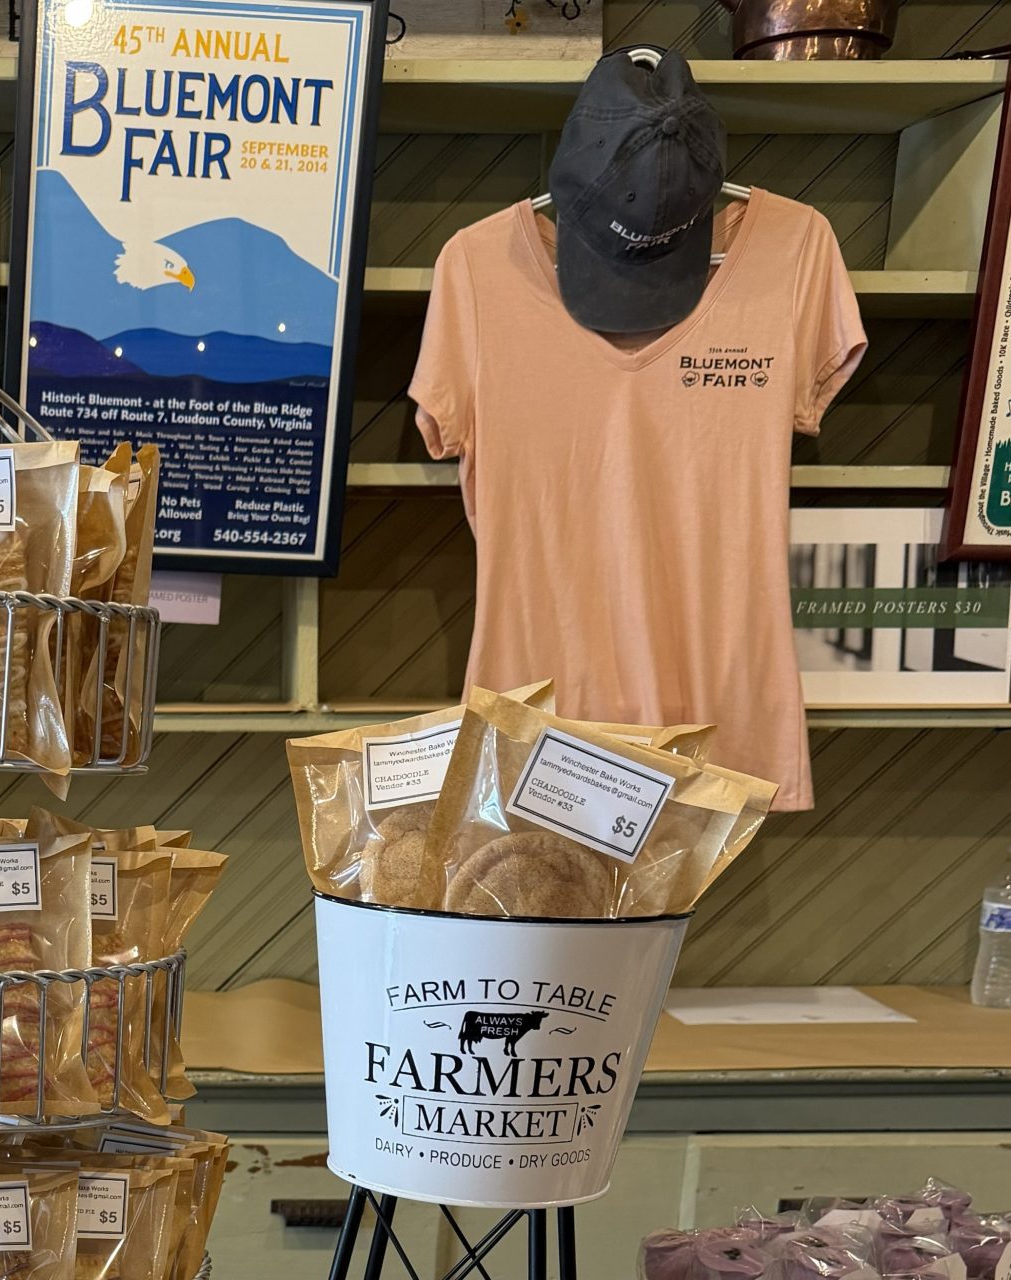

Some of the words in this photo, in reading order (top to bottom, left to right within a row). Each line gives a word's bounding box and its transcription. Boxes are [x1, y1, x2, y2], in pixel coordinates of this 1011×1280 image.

[113, 24, 166, 55] 45TH
[171, 28, 290, 64] ANNUAL
[60, 60, 335, 158] BLUEMONT
[241, 140, 329, 159] SEPTEMBER
[120, 127, 232, 203] FAIR
[240, 157, 257, 169] 20
[261, 158, 271, 170] &
[275, 158, 293, 172] 21,
[297, 159, 328, 173] 2014
[998, 343, 1008, 359] 10K
[679, 356, 775, 370] BLUEMONT
[702, 373, 747, 388] FAIR
[993, 365, 1004, 391] Goods
[41, 391, 86, 405] Historic
[88, 394, 142, 408] Bluemont
[153, 398, 164, 408] at
[168, 398, 186, 410] the
[188, 400, 213, 412] Foot
[217, 401, 230, 412] of
[232, 401, 251, 413] the
[253, 403, 278, 415] Blue
[281, 404, 313, 418] Ridge
[991, 391, 1001, 414] Baked
[40, 406, 74, 418] Route
[76, 407, 98, 419] 734
[101, 409, 118, 420] off
[121, 409, 154, 422] Route
[171, 413, 220, 425] Loudoun
[223, 415, 266, 430] County,
[269, 417, 313, 431] Virginia
[985, 416, 997, 457] Homemade
[980, 463, 991, 487] Village
[161, 496, 177, 507] No
[180, 496, 202, 508] Pets
[234, 499, 271, 512] Reduce
[273, 501, 305, 513] Plastic
[158, 508, 203, 521] Allowed
[227, 511, 249, 523] Bring
[251, 512, 269, 522] Your
[271, 513, 292, 523] Own
[293, 514, 311, 526] Bag!
[212, 529, 307, 546] 540-554-2367
[796, 601, 866, 614] FRAMED
[872, 600, 947, 614] POSTERS
[953, 600, 982, 614] $30
[539, 757, 654, 810] tammyedwardsbakes@gmail.com
[561, 754, 600, 776] Winchester
[599, 770, 619, 784] Bake
[619, 778, 642, 793] Works
[530, 777, 587, 806] CHAIDOODLE
[611, 814, 638, 838] $5
[11, 880, 31, 897] $5
[386, 979, 466, 1007] FARM
[478, 979, 520, 1000] TO
[532, 981, 617, 1016] TABLE
[474, 1015, 523, 1027] ALWAYS
[480, 1026, 519, 1036] FRESH
[364, 1041, 622, 1098] FARMERS
[414, 1103, 568, 1138] MARKET
[375, 1137, 414, 1158] DAIRY
[429, 1149, 503, 1170] PRODUCE
[518, 1153, 548, 1169] DRY
[550, 1148, 591, 1168] GOODS
[3, 1220, 22, 1235] $5
[99, 1209, 117, 1224] $5
